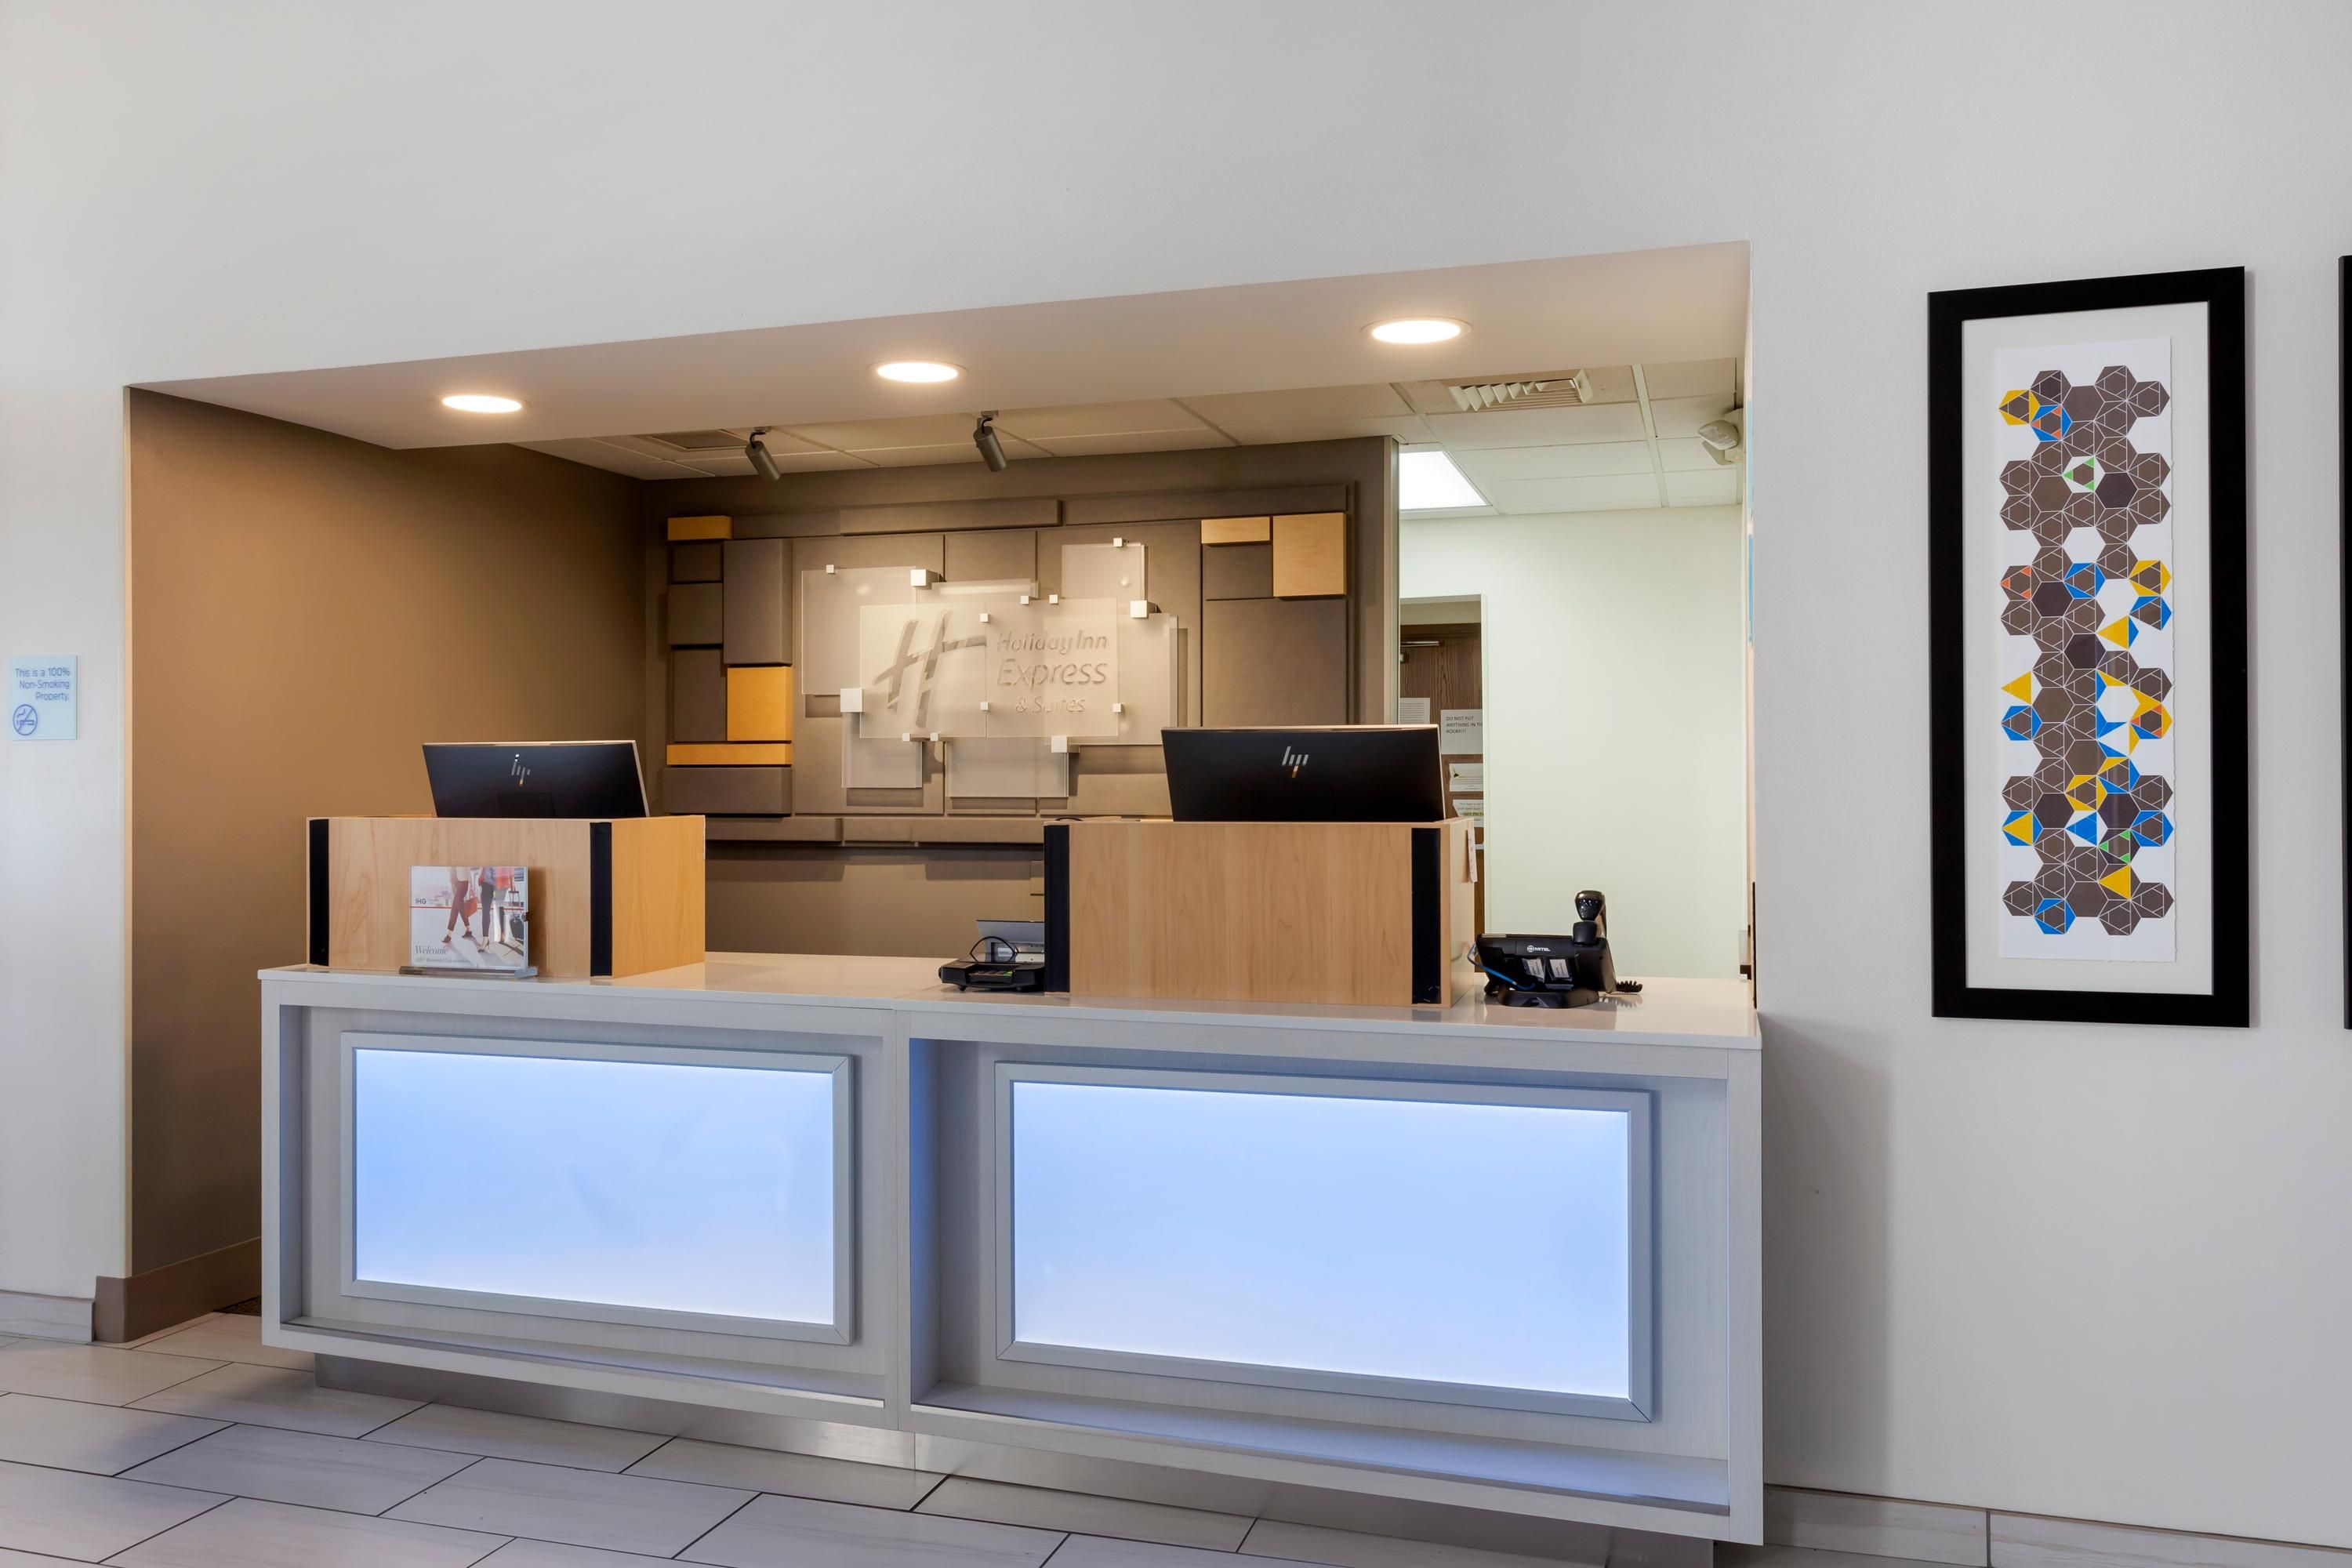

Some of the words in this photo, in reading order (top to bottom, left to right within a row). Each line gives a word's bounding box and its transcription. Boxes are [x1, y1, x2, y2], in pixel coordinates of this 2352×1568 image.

[996, 630, 1073, 655] Holiday
[1076, 630, 1107, 649] Inn
[15, 668, 30, 677] This
[32, 668, 38, 677] is
[48, 667, 71, 677] 100%
[996, 659, 1108, 690] Express
[19, 680, 70, 690] Non-Smoking
[35, 691, 70, 702] Property.
[1015, 696, 1028, 713] &
[1032, 695, 1086, 713] Suites
[1281, 746, 1309, 779] hp
[416, 945, 447, 955] Welcome
